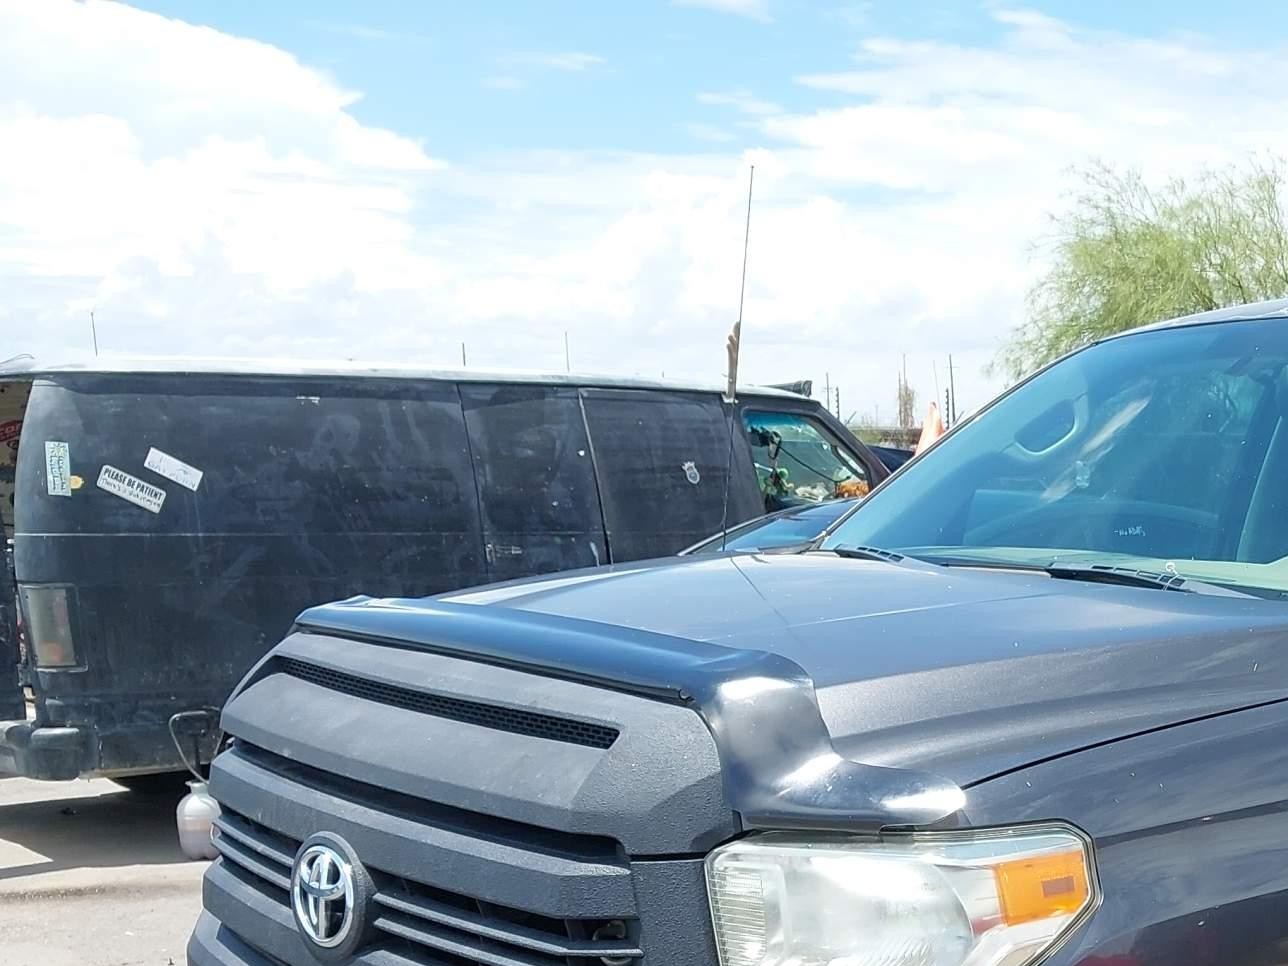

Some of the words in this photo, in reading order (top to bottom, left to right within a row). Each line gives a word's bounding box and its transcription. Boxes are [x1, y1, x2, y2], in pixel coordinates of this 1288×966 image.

[103, 467, 127, 488] PLEASE
[126, 476, 138, 489] BE
[136, 479, 164, 501] PATIENT
